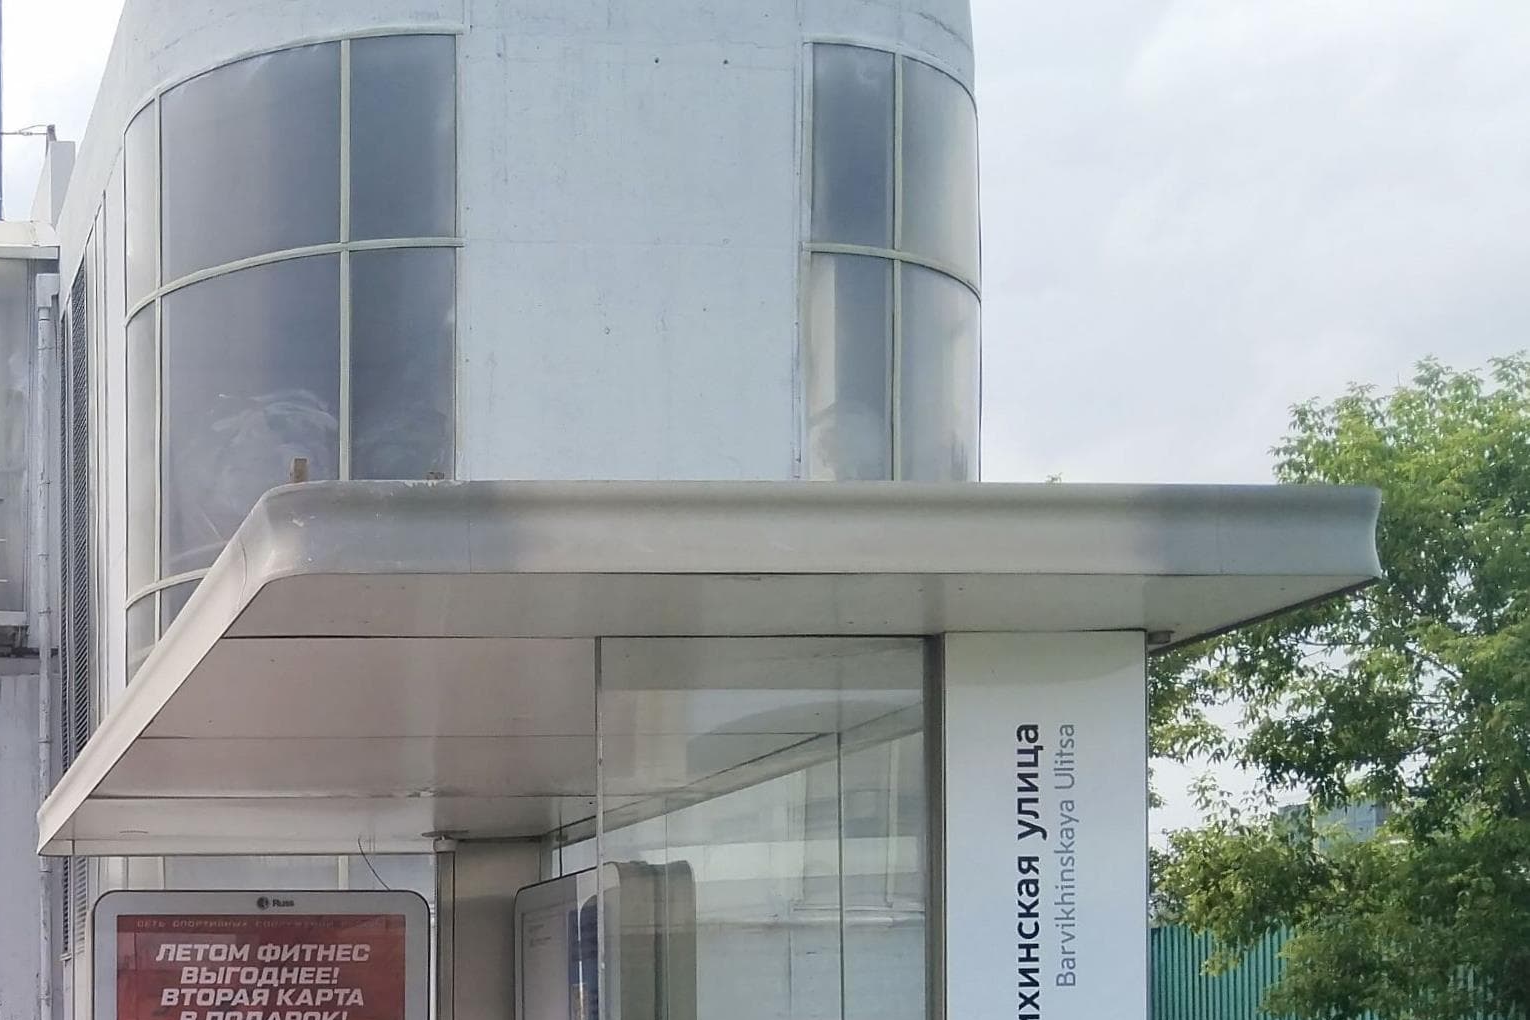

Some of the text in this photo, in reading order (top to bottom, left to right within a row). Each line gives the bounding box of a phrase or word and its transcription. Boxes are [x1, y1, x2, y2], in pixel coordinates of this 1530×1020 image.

[1015, 723, 1047, 841] улица
[1053, 723, 1079, 987] Barvikhinskaya Ulitsa
[155, 943, 371, 962] ЛЕТОМ ФИТНЕС
[180, 966, 340, 987] ВЫГОДНЕЕ!
[161, 988, 364, 1007] ВТОРАЯ КАРТА
